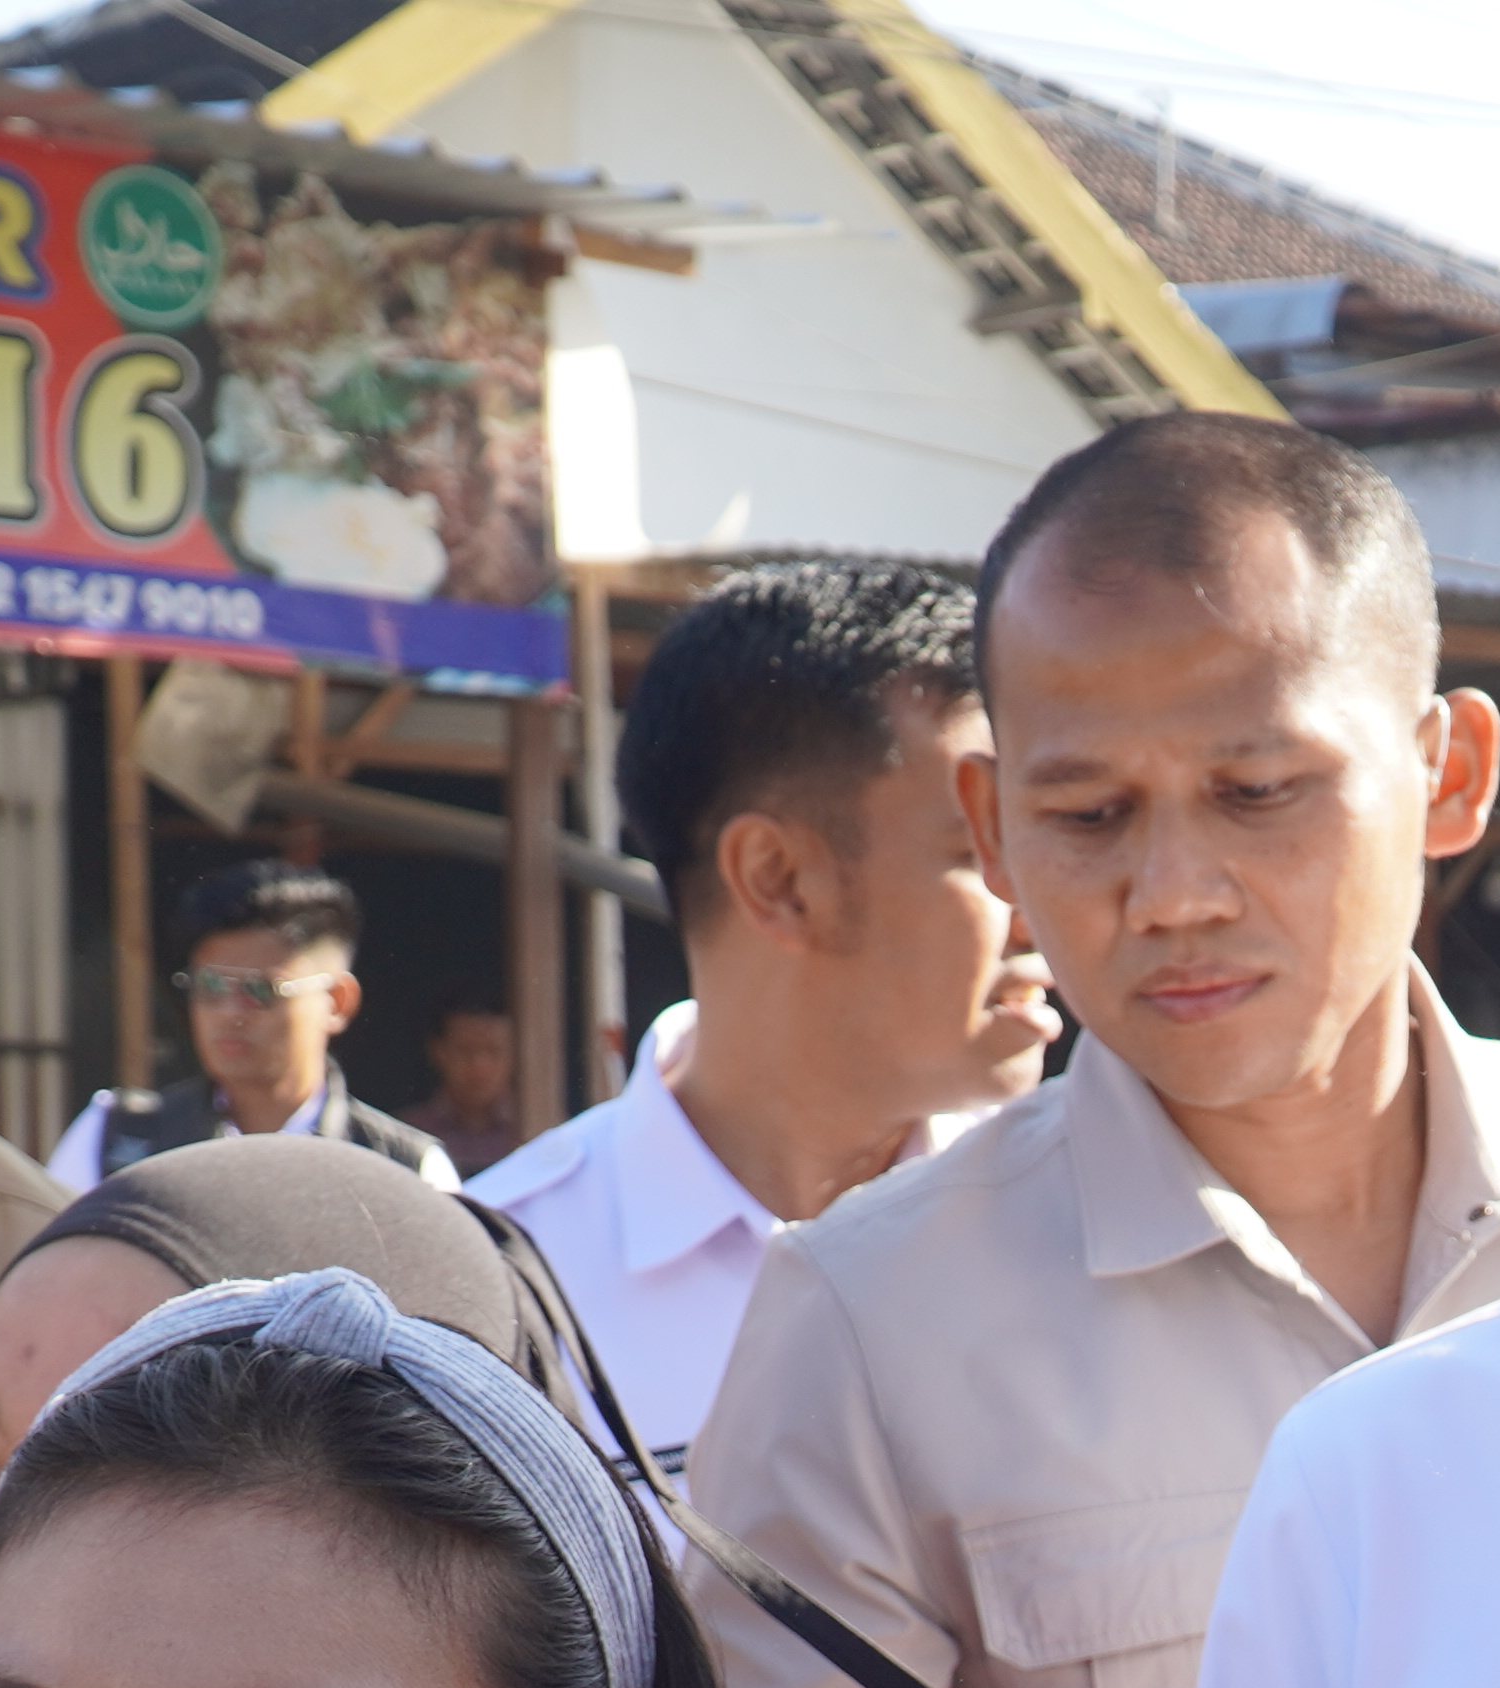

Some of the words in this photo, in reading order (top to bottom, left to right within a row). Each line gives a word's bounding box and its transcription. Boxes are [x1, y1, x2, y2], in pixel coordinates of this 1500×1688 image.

[73, 350, 192, 538] 6
[21, 564, 137, 631] 1547
[138, 576, 266, 642] 9010
